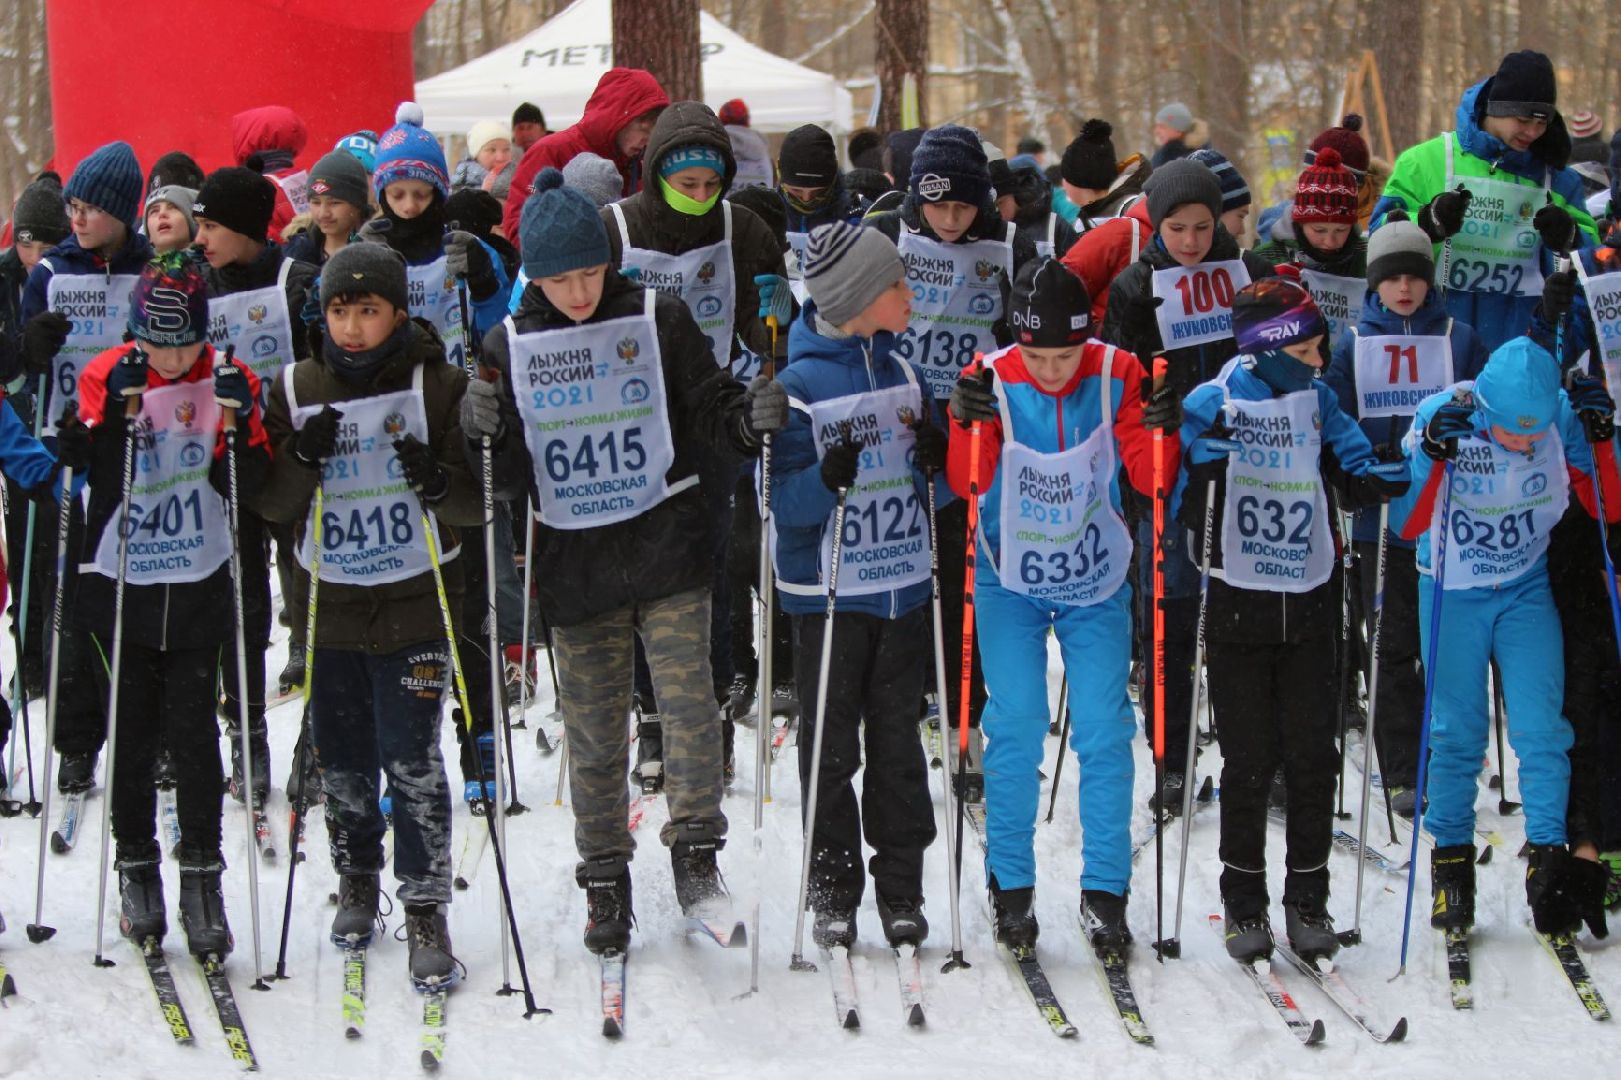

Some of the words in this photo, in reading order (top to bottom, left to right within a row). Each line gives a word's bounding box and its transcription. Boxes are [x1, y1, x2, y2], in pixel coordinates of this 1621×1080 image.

[1464, 207, 1504, 222] ОССИИ
[1463, 220, 1498, 239] 021
[637, 269, 683, 285] ЫЖНЯ
[1449, 258, 1526, 296] 6252
[54, 289, 107, 305] ЛЫЖНЯ
[912, 284, 949, 305] 021
[1174, 267, 1236, 316] 100
[1309, 290, 1348, 306] ЫЖНЯ
[69, 320, 104, 336] 021
[1013, 306, 1041, 330] DNB
[894, 326, 978, 368] 6138
[527, 348, 593, 371] ЛЫЖНЯ
[1383, 344, 1419, 385] 71
[528, 364, 595, 388] РОССИИ
[532, 384, 594, 410] 2021
[1234, 427, 1294, 448] РОССИИ
[544, 427, 647, 483] 6415
[1237, 449, 1294, 469] 2021
[1457, 459, 1496, 475] ССИИ
[322, 458, 360, 481] 021
[1017, 465, 1072, 489] ЛЫЖНЯ
[554, 474, 647, 500] МОСКОВСКАЯ
[1019, 481, 1074, 506] РОССИИ
[1453, 476, 1495, 495] 021
[116, 488, 204, 540] 6401
[571, 496, 635, 517] ОБЛАСТЬ
[1018, 498, 1073, 525] 2021
[322, 502, 414, 551] 6418
[841, 492, 922, 548] 6122
[1451, 508, 1536, 552] 6287
[843, 538, 924, 564] МОСКОВСКАЯ
[130, 555, 192, 573] ОБЛАСТЬ
[858, 562, 916, 581] ОБЛАСТЬ
